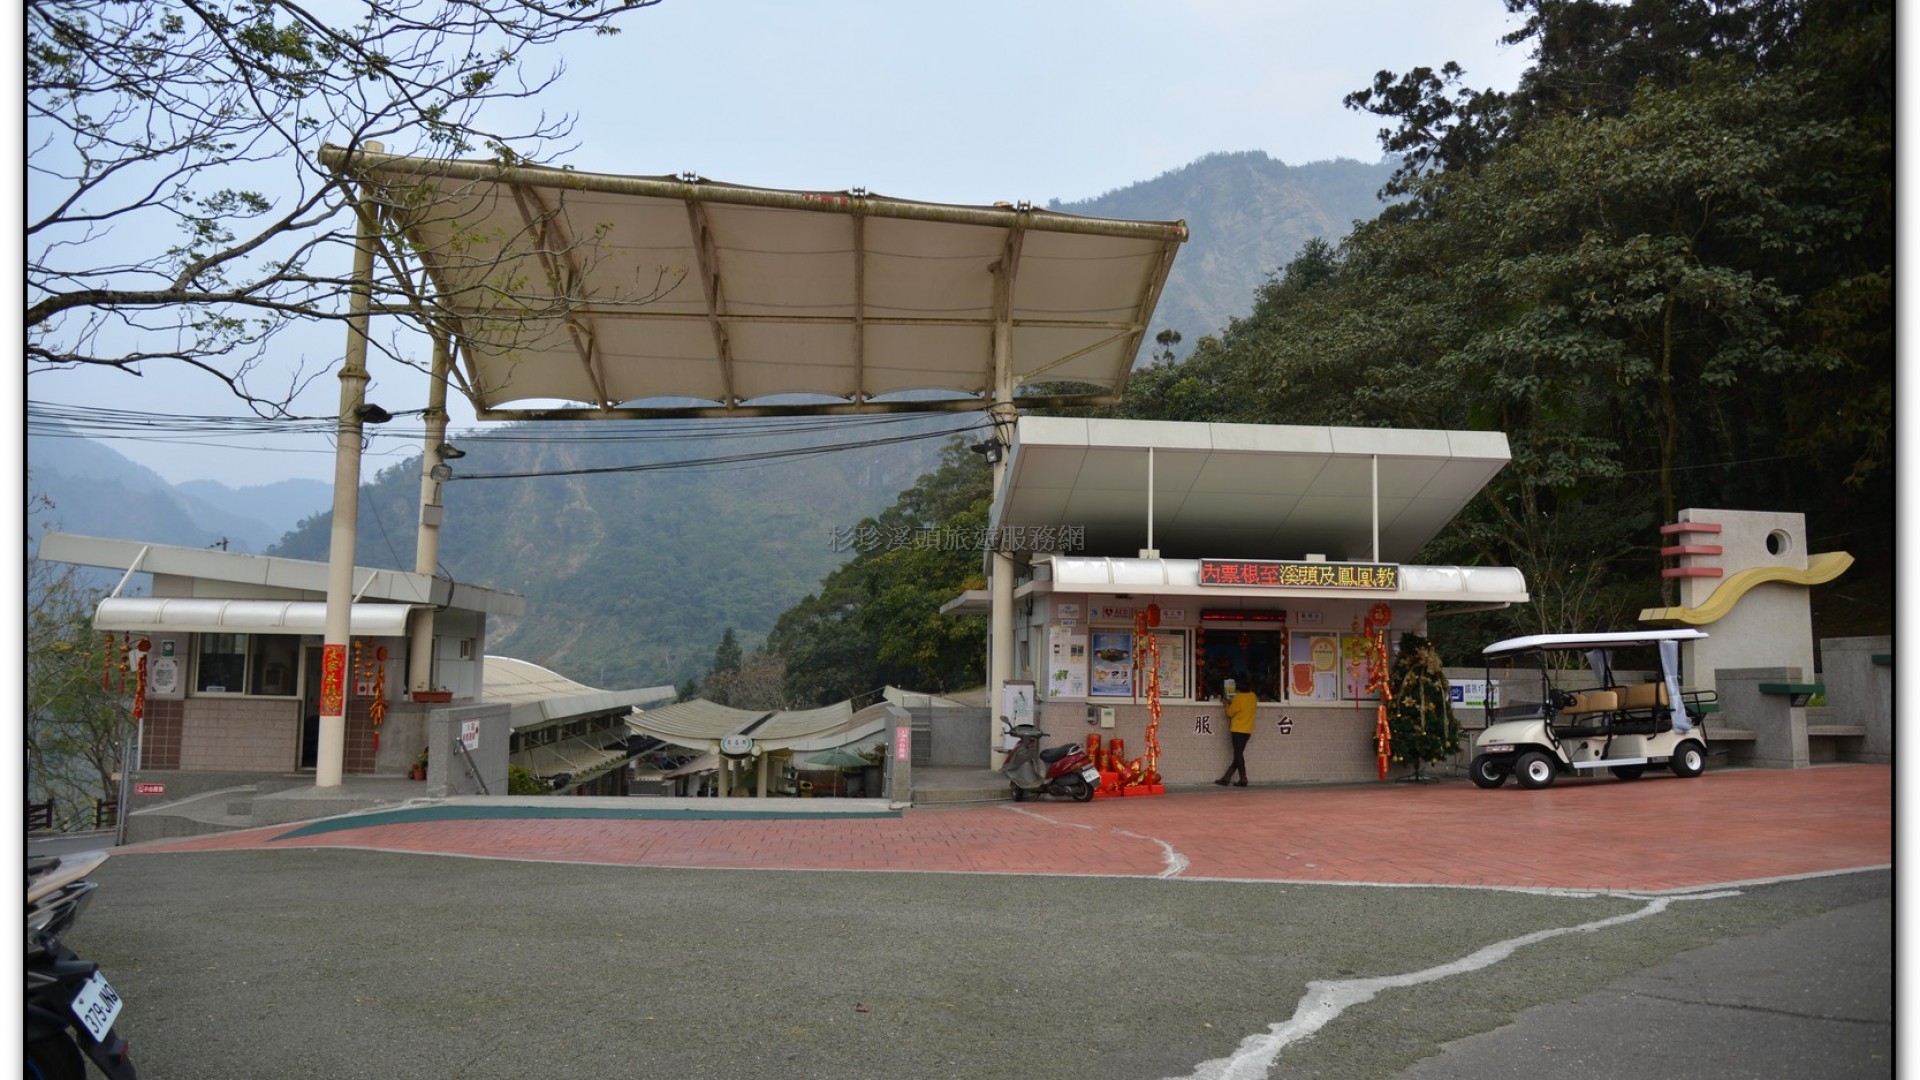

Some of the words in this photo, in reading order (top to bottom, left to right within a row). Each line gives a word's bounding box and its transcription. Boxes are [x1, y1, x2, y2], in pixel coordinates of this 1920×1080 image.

[1201, 563, 1396, 588] 內票根至溪頭及鳳凰教
